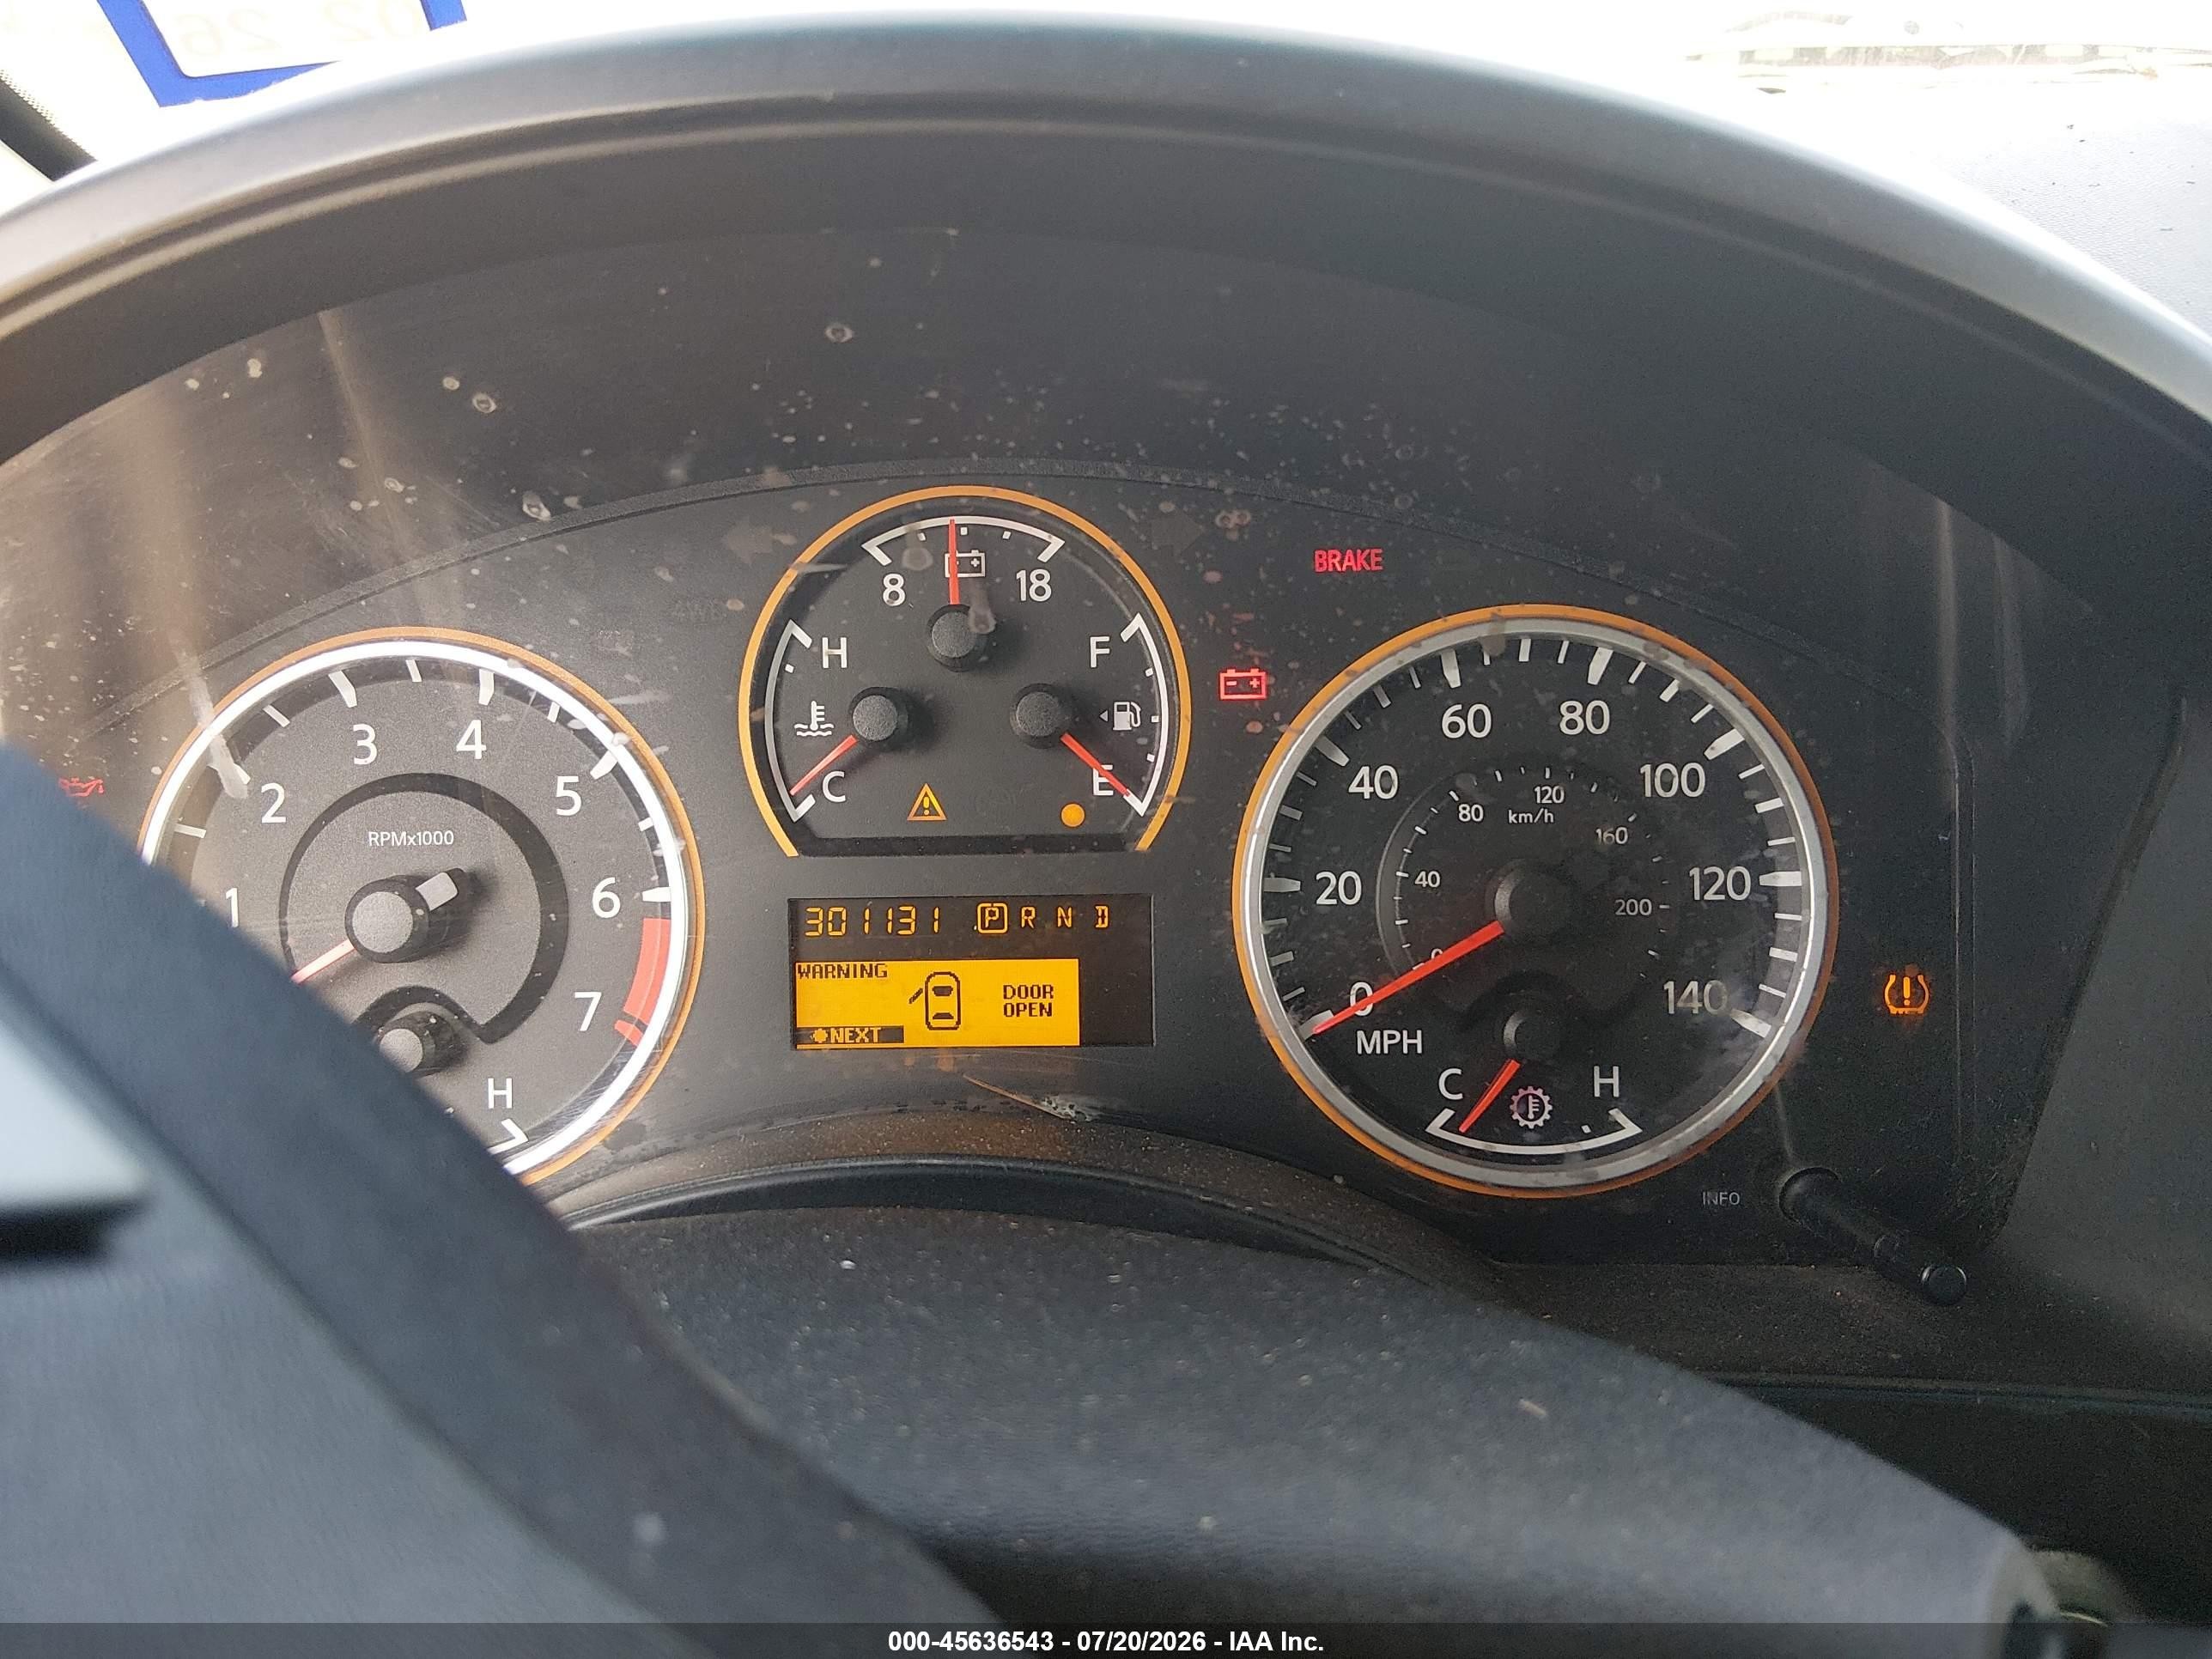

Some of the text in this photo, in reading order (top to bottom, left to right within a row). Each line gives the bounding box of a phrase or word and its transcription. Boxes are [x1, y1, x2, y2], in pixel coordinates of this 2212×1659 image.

[1315, 549, 1383, 573] BRAKE
[884, 574, 905, 605] 8
[1017, 569, 1051, 601] 18
[823, 637, 847, 668] H
[1091, 636, 1109, 667] F
[1443, 704, 1491, 738] 60
[1560, 701, 1609, 734] 80
[353, 724, 377, 764] 3
[456, 720, 486, 759] 4
[822, 771, 846, 802] C
[1093, 765, 1113, 795] E
[1348, 765, 1399, 799] 40
[1534, 786, 1564, 803] 120
[1641, 763, 1705, 797] 100
[261, 783, 286, 823] 2
[556, 776, 581, 816] 5
[1459, 804, 1483, 821] 80
[1509, 808, 1553, 823] km/h
[368, 830, 453, 846] RPMx1000
[1596, 827, 1628, 844] 160
[1316, 872, 1361, 904] 20
[1415, 872, 1440, 887] 40
[1690, 866, 1751, 900] 120
[226, 887, 239, 927] 1
[592, 878, 620, 918] 6
[1616, 899, 1651, 915] 200
[805, 907, 939, 935] 301131
[985, 906, 1108, 927] P R N D
[797, 963, 888, 980] WARNING
[1004, 985, 1054, 1000] DOOR
[1350, 982, 1372, 1016] 0
[1664, 981, 1728, 1015] 140
[574, 992, 601, 1031] 7
[1004, 1003, 1052, 1017] OPEN
[830, 1027, 881, 1044] NEXT
[1357, 1030, 1422, 1054] MPH
[488, 1079, 512, 1109] H
[1439, 1068, 1462, 1099] C
[1594, 1066, 1619, 1097] H
[1703, 1192, 1740, 1205] INFO
